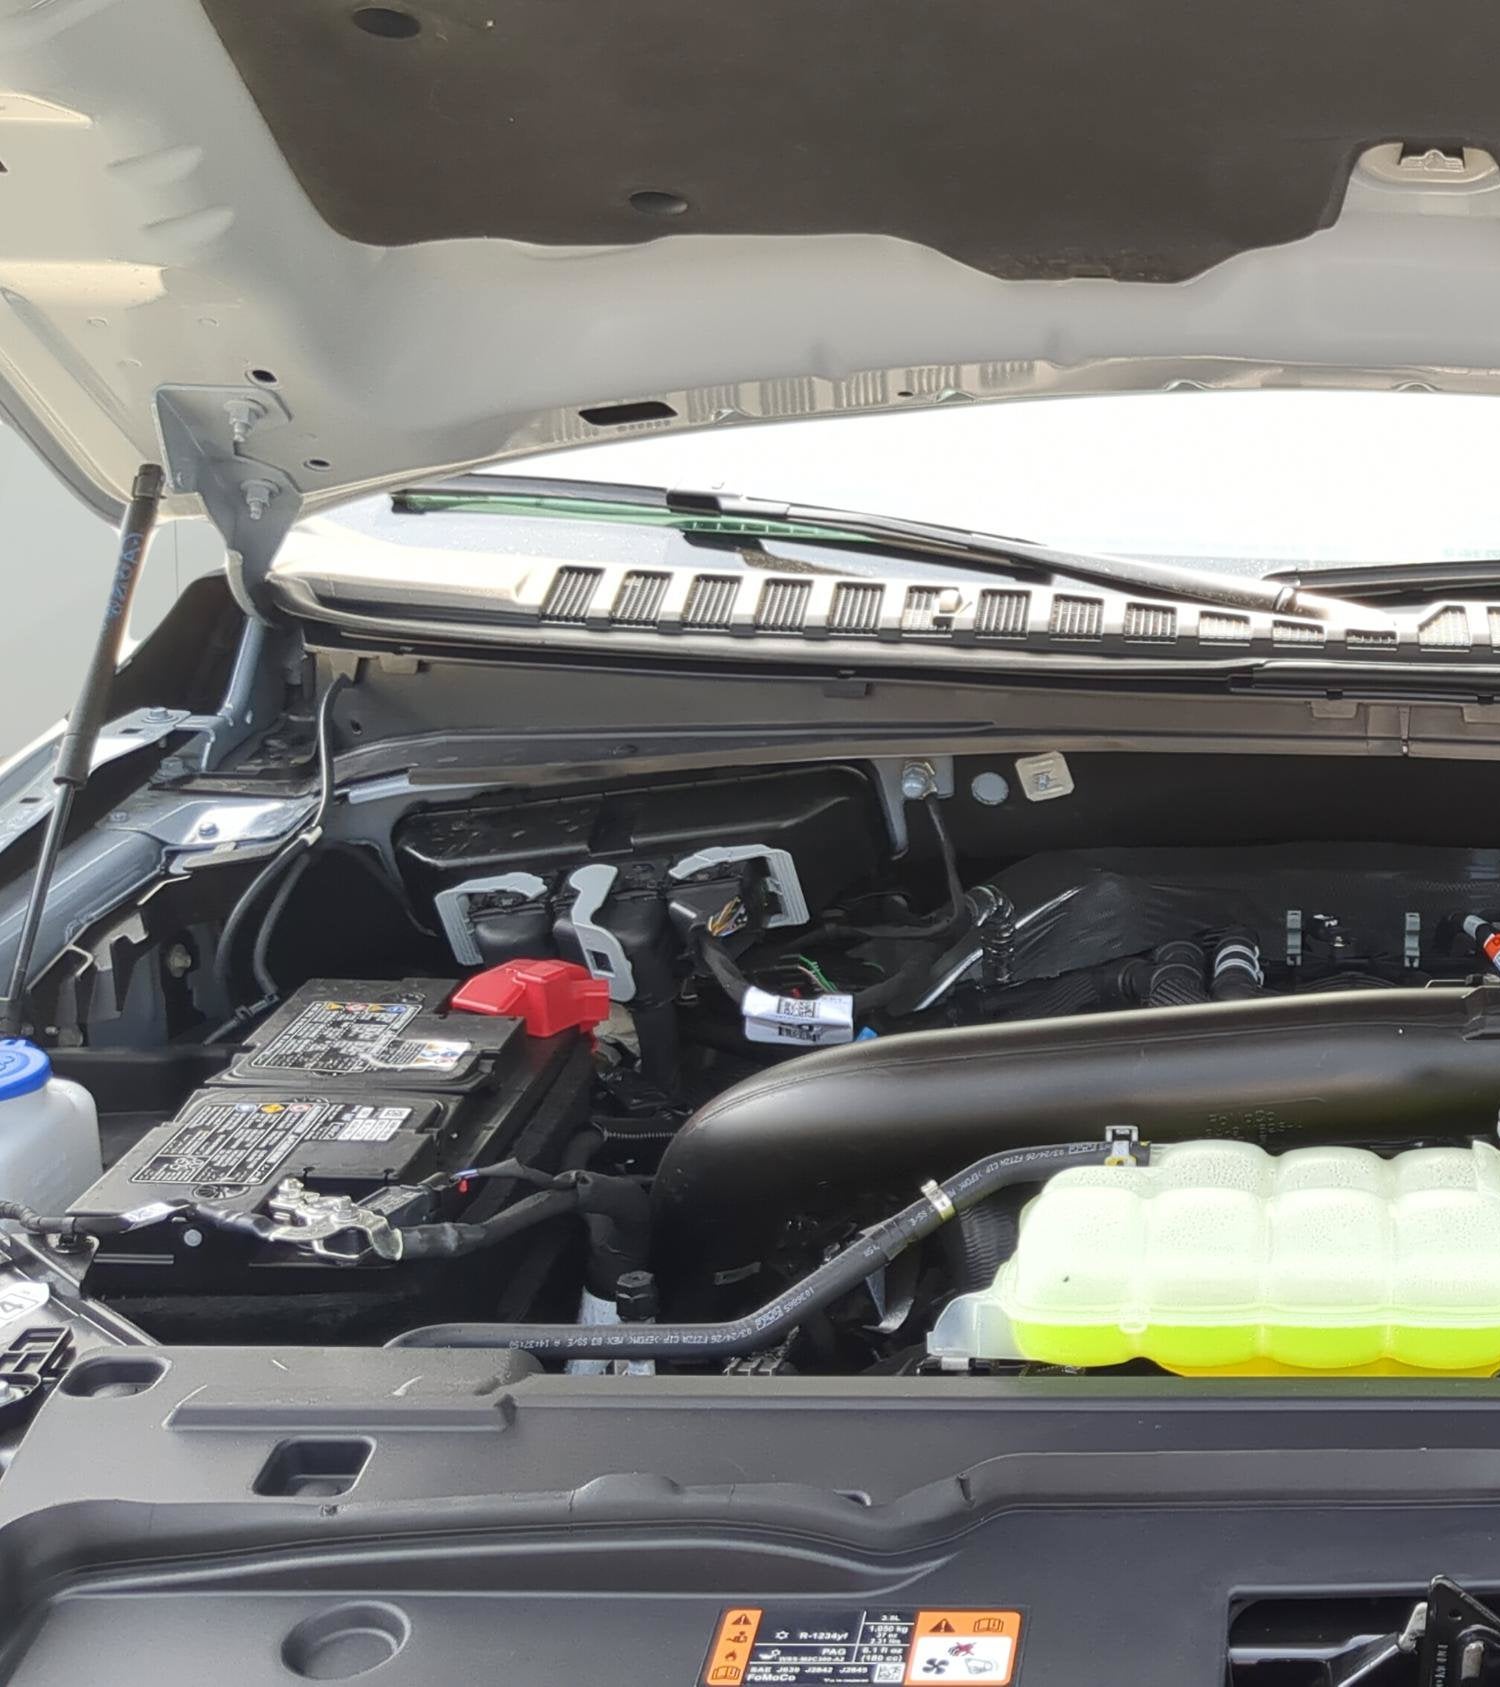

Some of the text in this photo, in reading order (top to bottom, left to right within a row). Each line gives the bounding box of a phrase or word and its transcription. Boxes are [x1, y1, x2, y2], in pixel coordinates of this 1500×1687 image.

[798, 1631, 848, 1643] R-1234yf
[821, 1648, 847, 1656] PAG
[749, 1666, 772, 1674] SAE
[746, 1673, 797, 1682] FoMoCo
